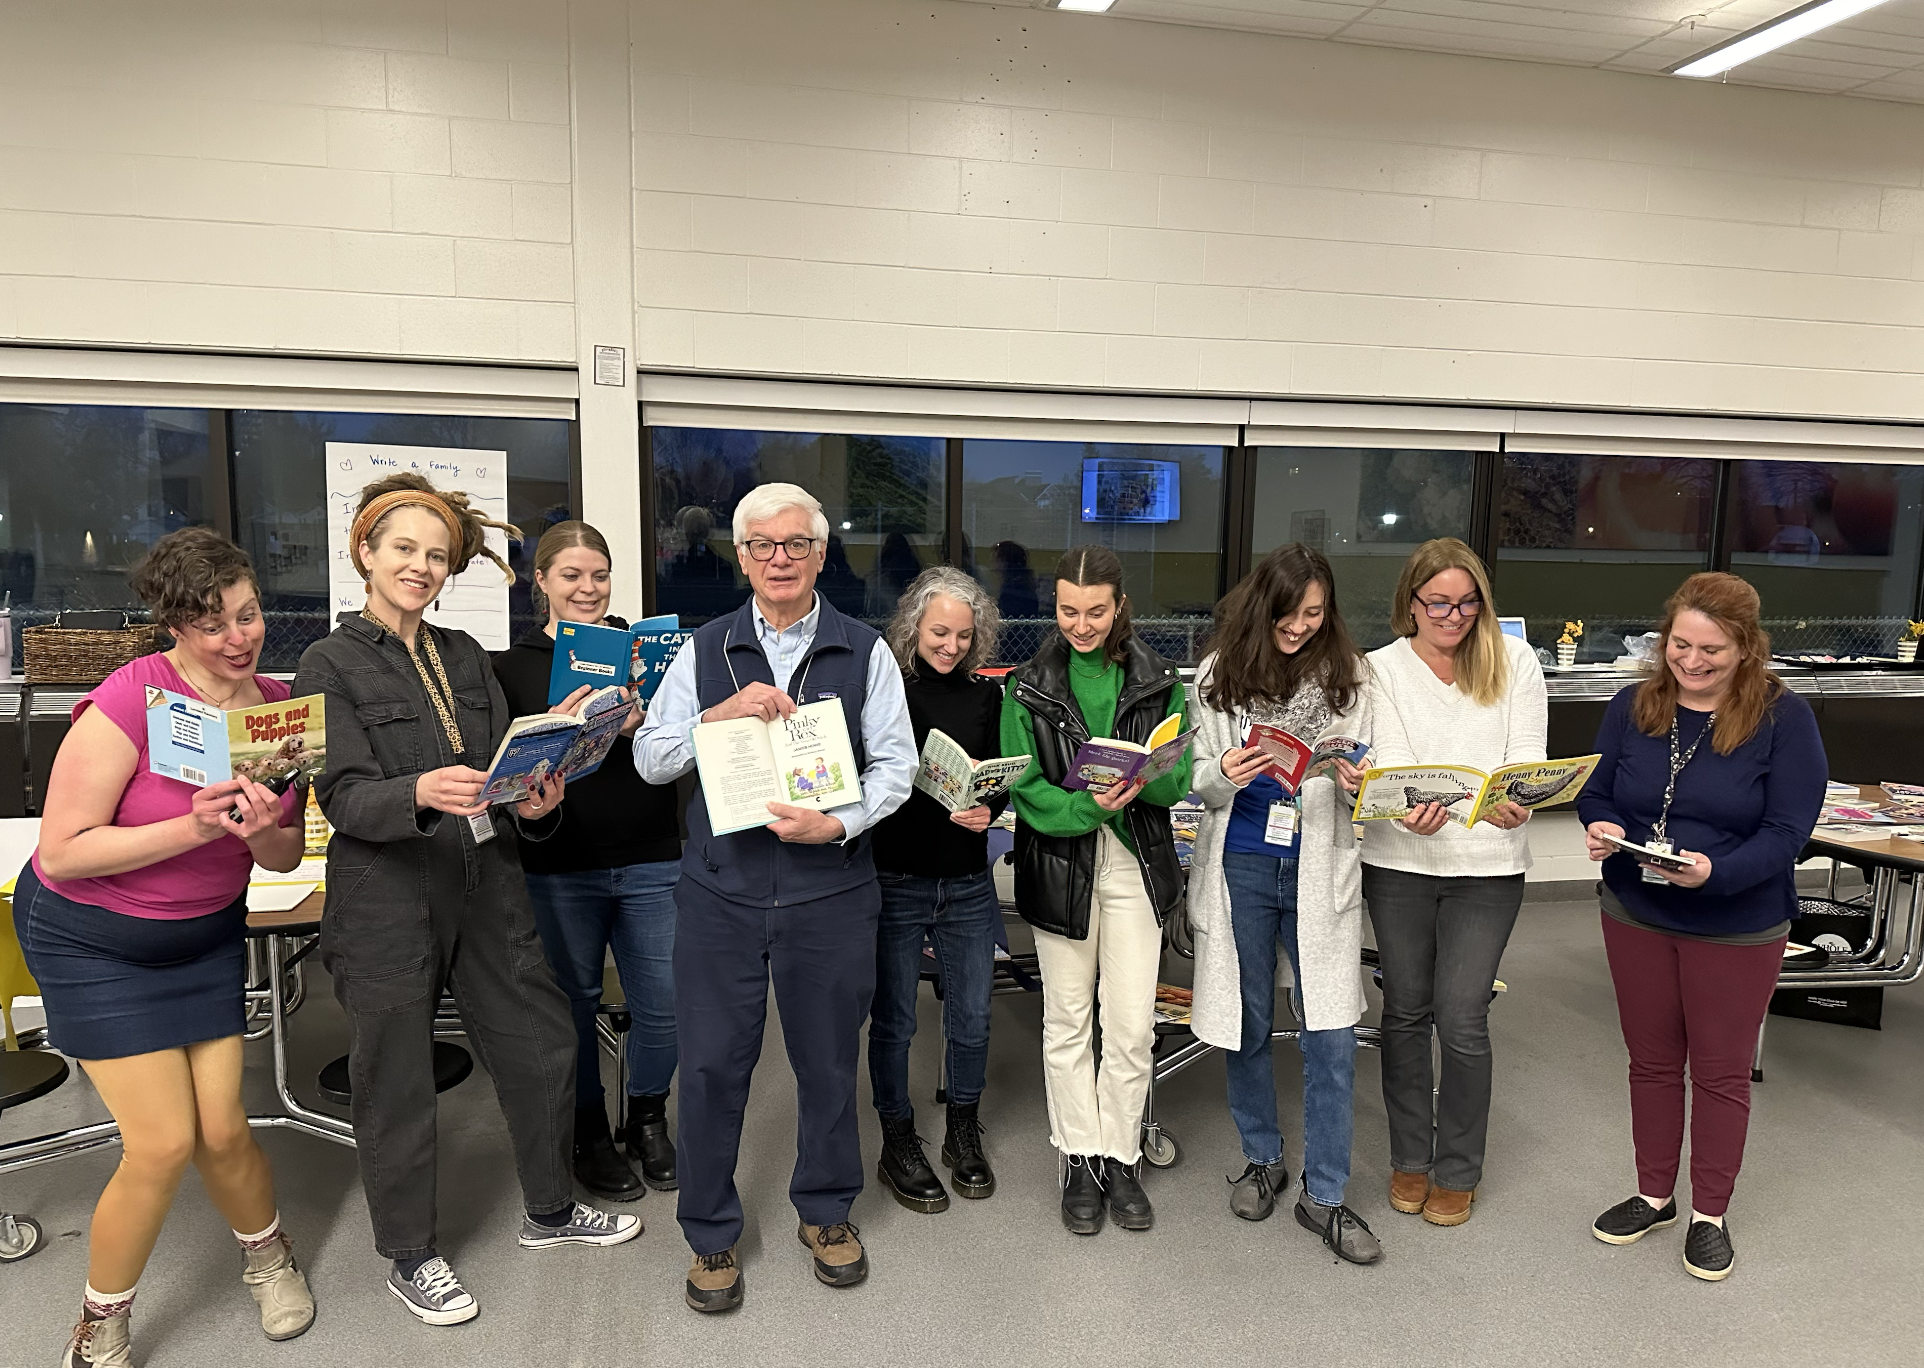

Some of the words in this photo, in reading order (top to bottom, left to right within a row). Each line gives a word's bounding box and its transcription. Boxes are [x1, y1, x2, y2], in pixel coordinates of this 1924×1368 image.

[369, 455, 398, 467] Write
[411, 461, 420, 469] a
[338, 597, 353, 607] We
[637, 635, 659, 643] THE
[660, 632, 693, 645] CAT
[668, 645, 680, 653] IN
[664, 653, 676, 661] TH
[244, 712, 280, 730] Dogs
[285, 703, 310, 722] and
[783, 715, 821, 731] Pinky
[250, 721, 306, 743] Puppies
[790, 728, 818, 741] Rex
[1001, 763, 1029, 774] KITTY
[1501, 771, 1533, 782] Henny
[1535, 767, 1568, 778] Penny
